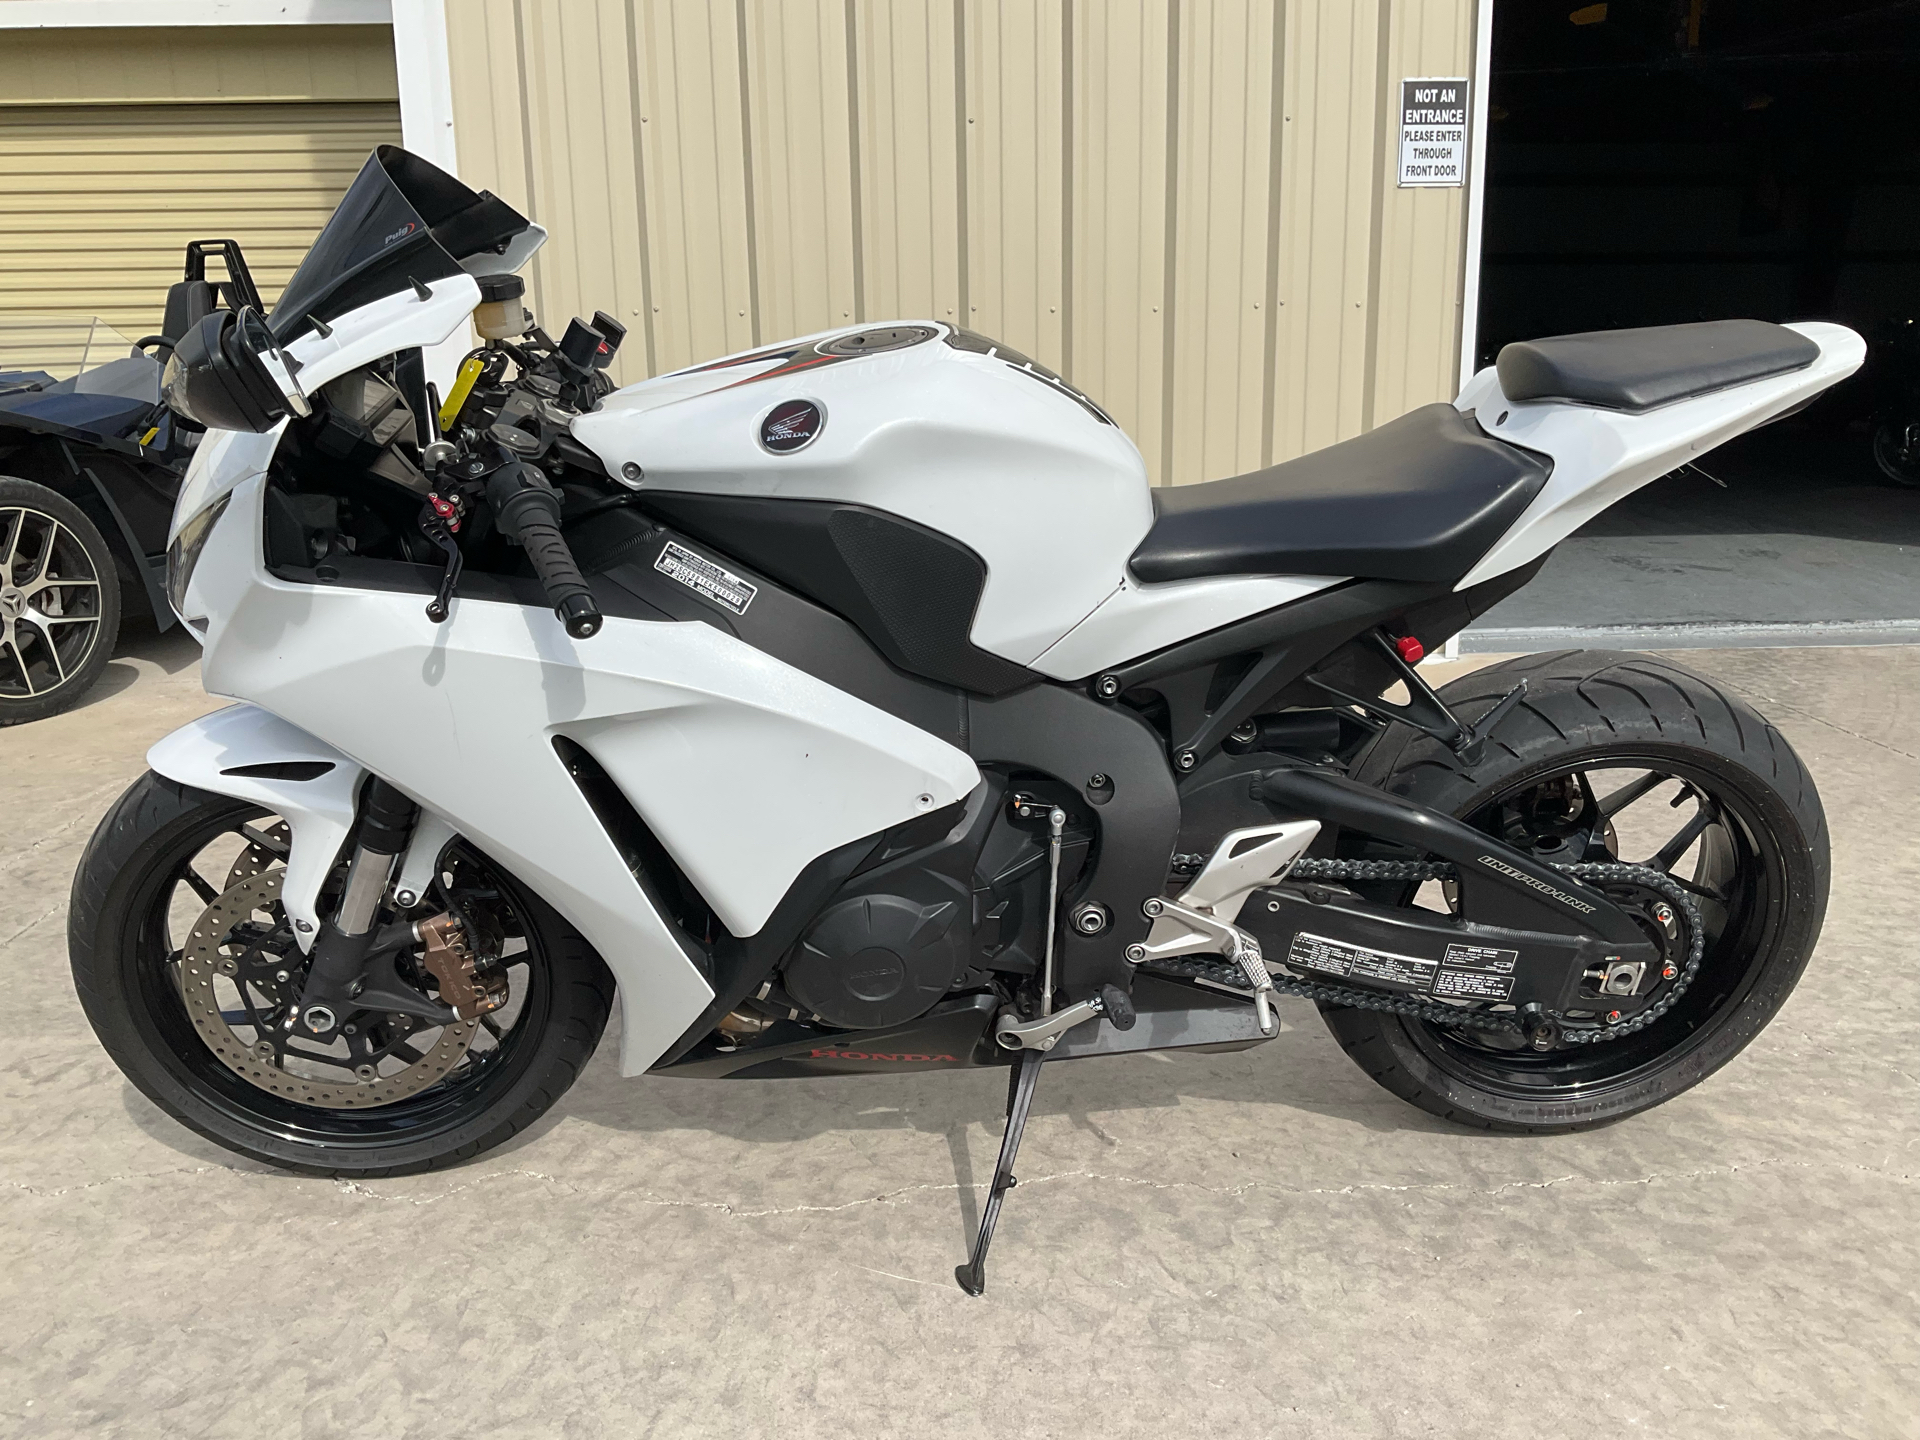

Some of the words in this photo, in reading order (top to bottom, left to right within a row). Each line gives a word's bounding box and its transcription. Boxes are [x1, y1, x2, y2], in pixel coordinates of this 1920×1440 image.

[1415, 89, 1438, 102] NOT
[1440, 89, 1455, 102] AN
[1406, 109, 1463, 123] ENTRANCE
[1404, 130, 1434, 141] PLEASE
[1436, 130, 1462, 141] ENTER
[1413, 148, 1452, 159] THROUGH
[1406, 165, 1432, 176] FRONT
[1434, 165, 1456, 176] DOOR
[385, 226, 409, 244] Puig
[766, 431, 810, 442] HONDA
[671, 571, 695, 587] 2014
[1477, 855, 1519, 878] UNIT
[437, 957, 462, 1000] TOKICO
[810, 1049, 960, 1062] HONDA
